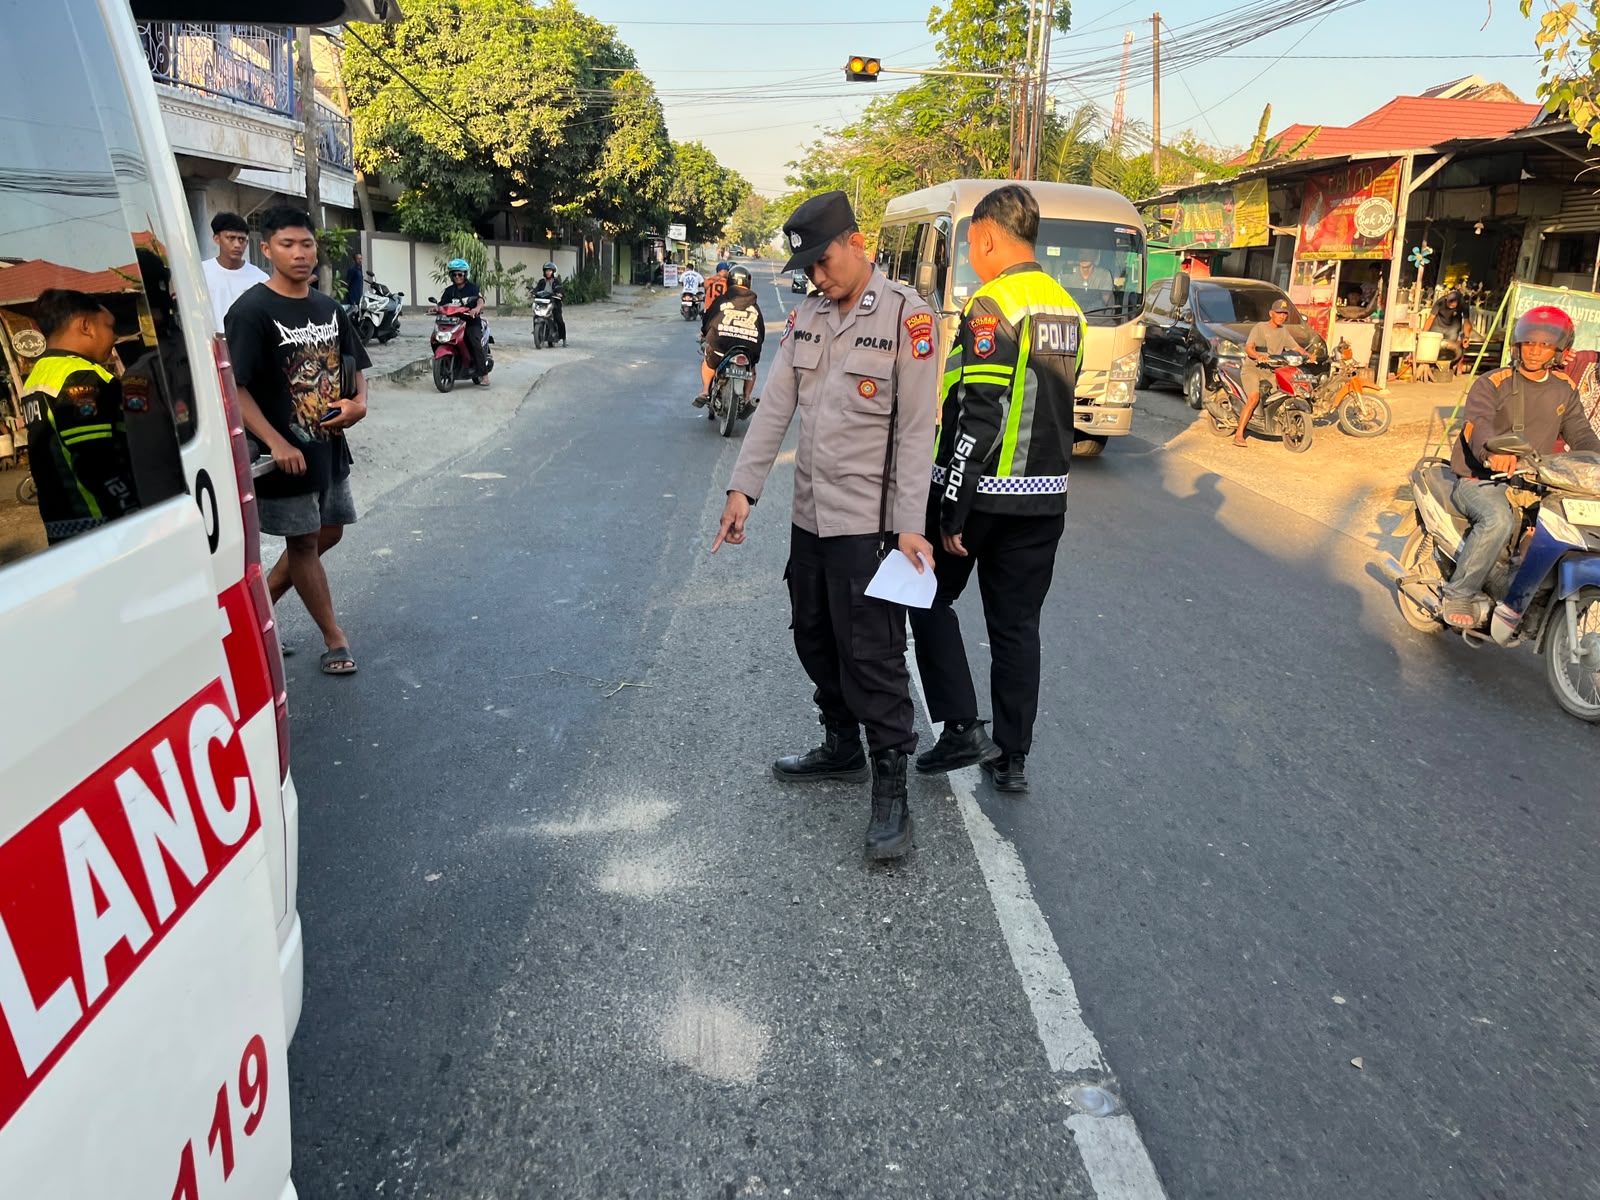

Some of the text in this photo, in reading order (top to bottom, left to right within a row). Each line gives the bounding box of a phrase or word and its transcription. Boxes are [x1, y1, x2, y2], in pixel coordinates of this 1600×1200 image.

[814, 334, 821, 344] S
[854, 336, 893, 351] POLRI
[944, 433, 977, 502] POLISI
